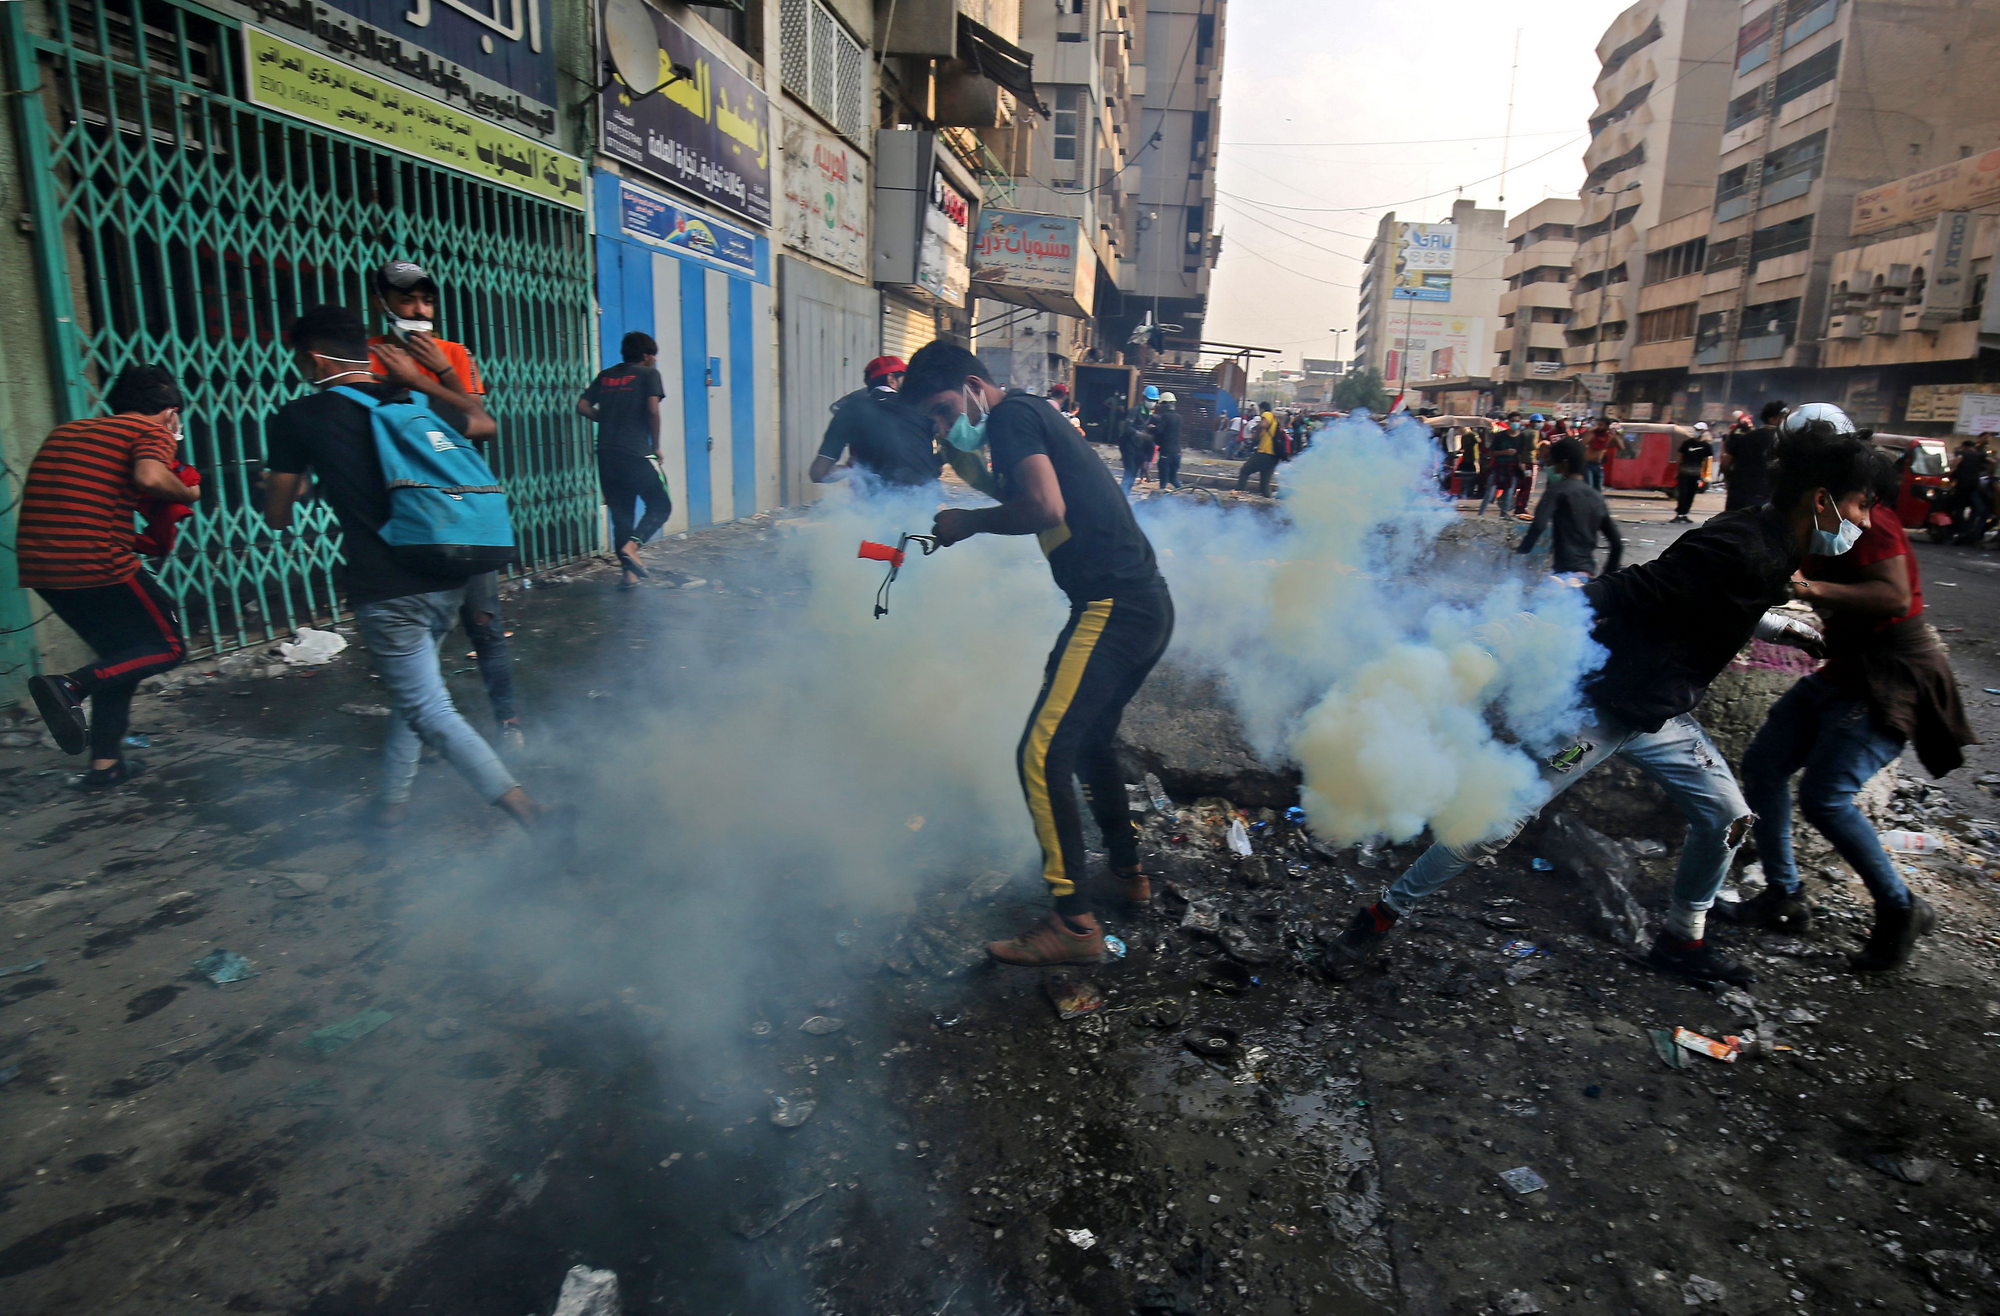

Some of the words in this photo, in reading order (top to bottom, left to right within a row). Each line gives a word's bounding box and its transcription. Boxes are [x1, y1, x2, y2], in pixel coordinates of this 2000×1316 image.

[256, 46, 304, 74] العراقي
[307, 67, 347, 91] المركزي
[350, 80, 379, 102] البنك
[381, 90, 401, 112] قبل
[401, 104, 416, 118] من
[715, 85, 769, 171] رشيد
[475, 139, 540, 182] الجنوب
[543, 151, 583, 197] شركة
[1004, 227, 1071, 261] مشويات
